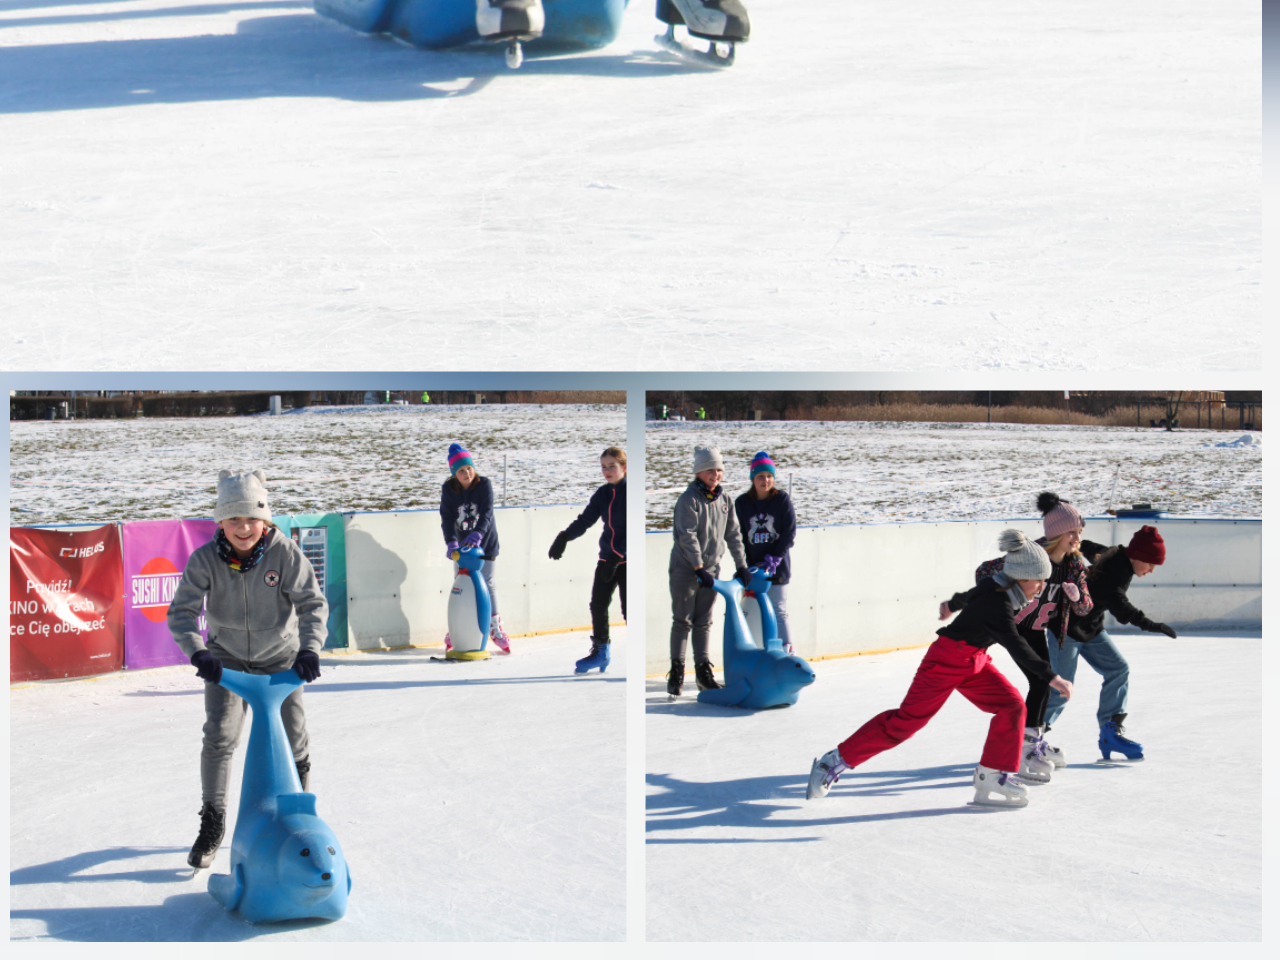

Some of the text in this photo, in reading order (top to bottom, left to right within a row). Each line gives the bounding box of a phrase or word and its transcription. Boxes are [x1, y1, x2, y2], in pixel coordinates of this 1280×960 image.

[132, 577, 160, 605] SUSHI
[162, 576, 182, 602] KIN
[10, 600, 38, 615] INO
[28, 620, 51, 637] Cię
